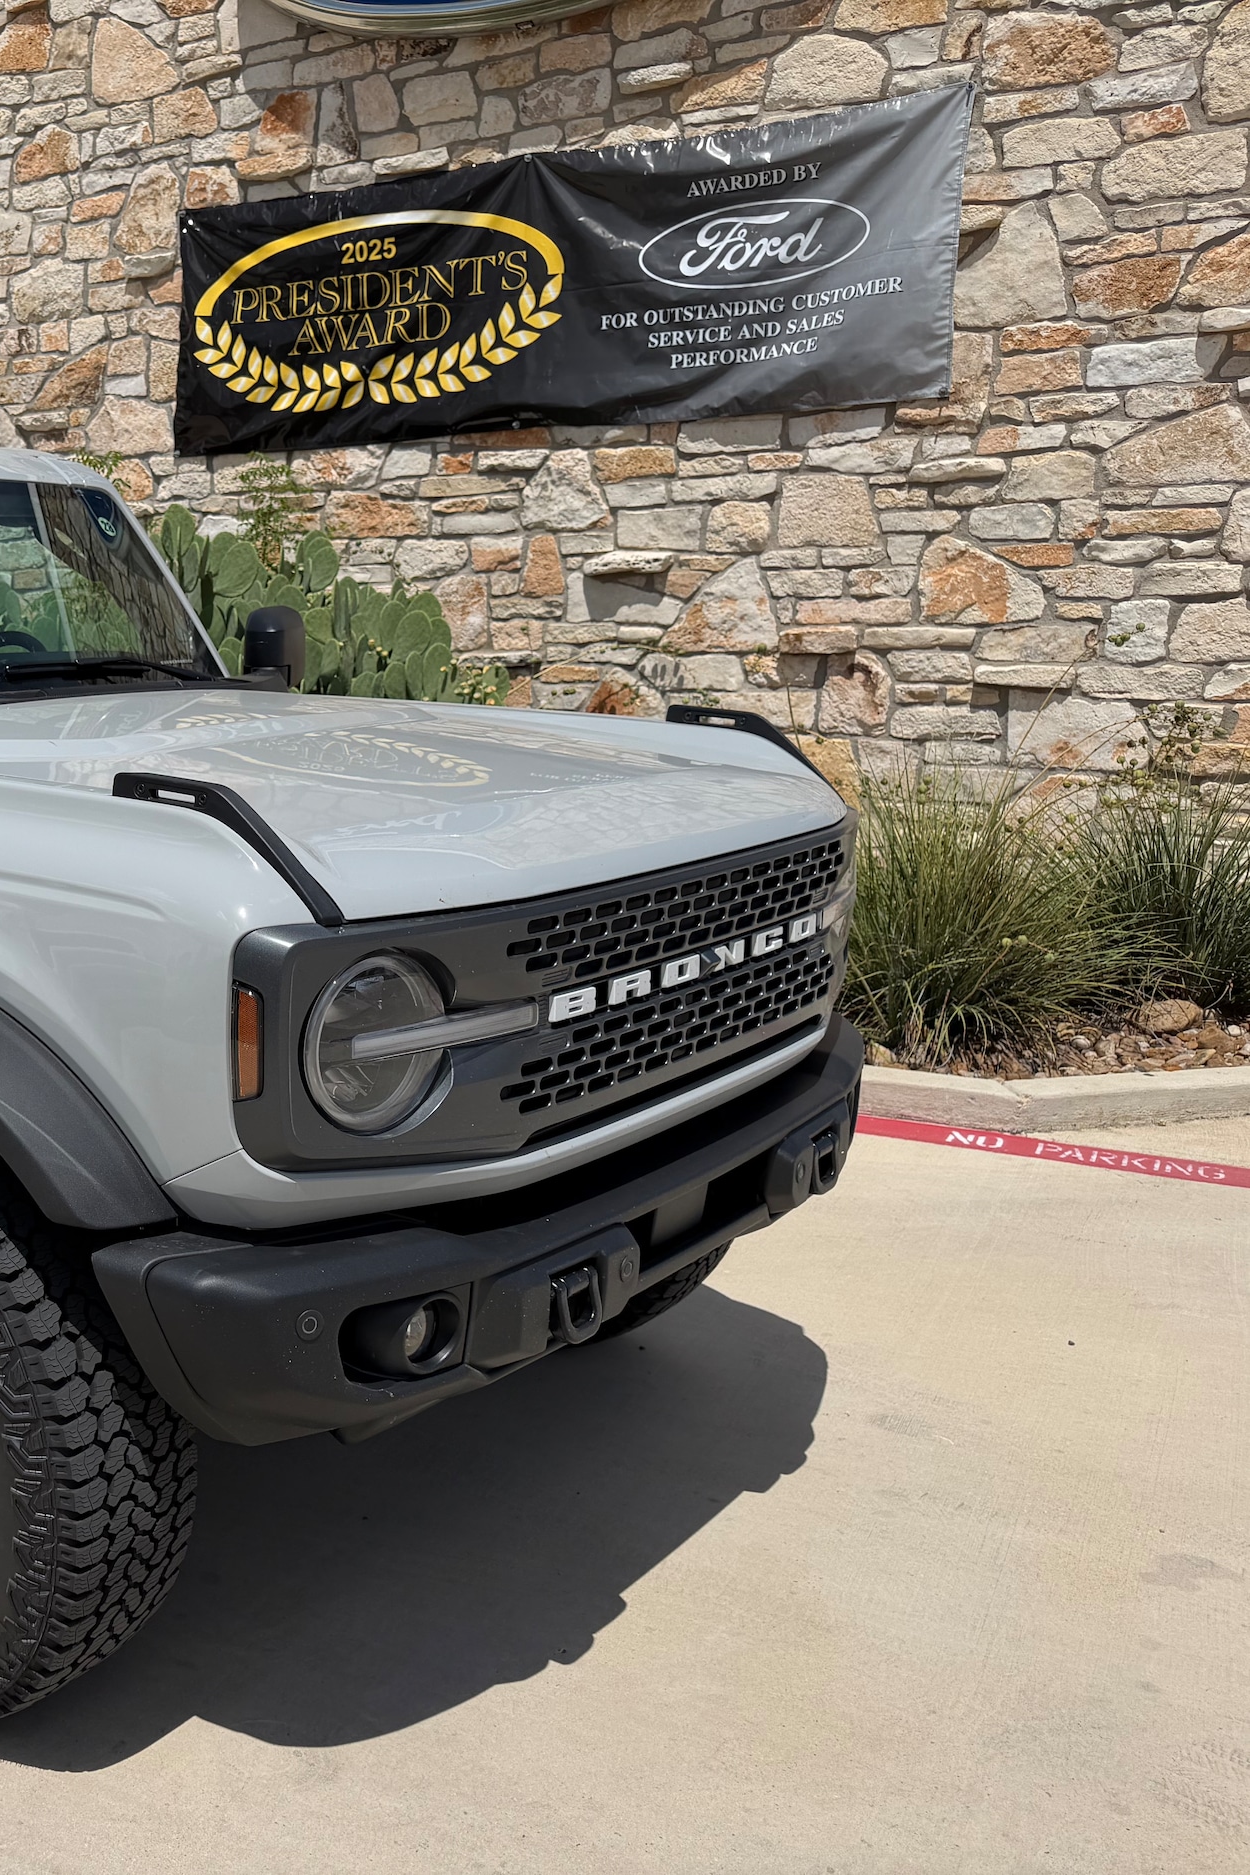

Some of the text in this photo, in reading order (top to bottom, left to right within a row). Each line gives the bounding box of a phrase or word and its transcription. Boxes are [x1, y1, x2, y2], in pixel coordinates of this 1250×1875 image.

[686, 161, 823, 198] AWARDED BY
[340, 237, 398, 265] 2025
[678, 210, 824, 278] Ford
[230, 249, 530, 325] PRESIDENT'S
[599, 275, 904, 331] FOR OUTSTANDING CUSTOMER
[287, 302, 453, 357] AWARD
[647, 309, 846, 350] SERVICE AND SALES
[669, 336, 819, 370] PERFORMANCE
[548, 911, 818, 1023] BRONCO
[944, 1130, 1227, 1181] NO PARKING
